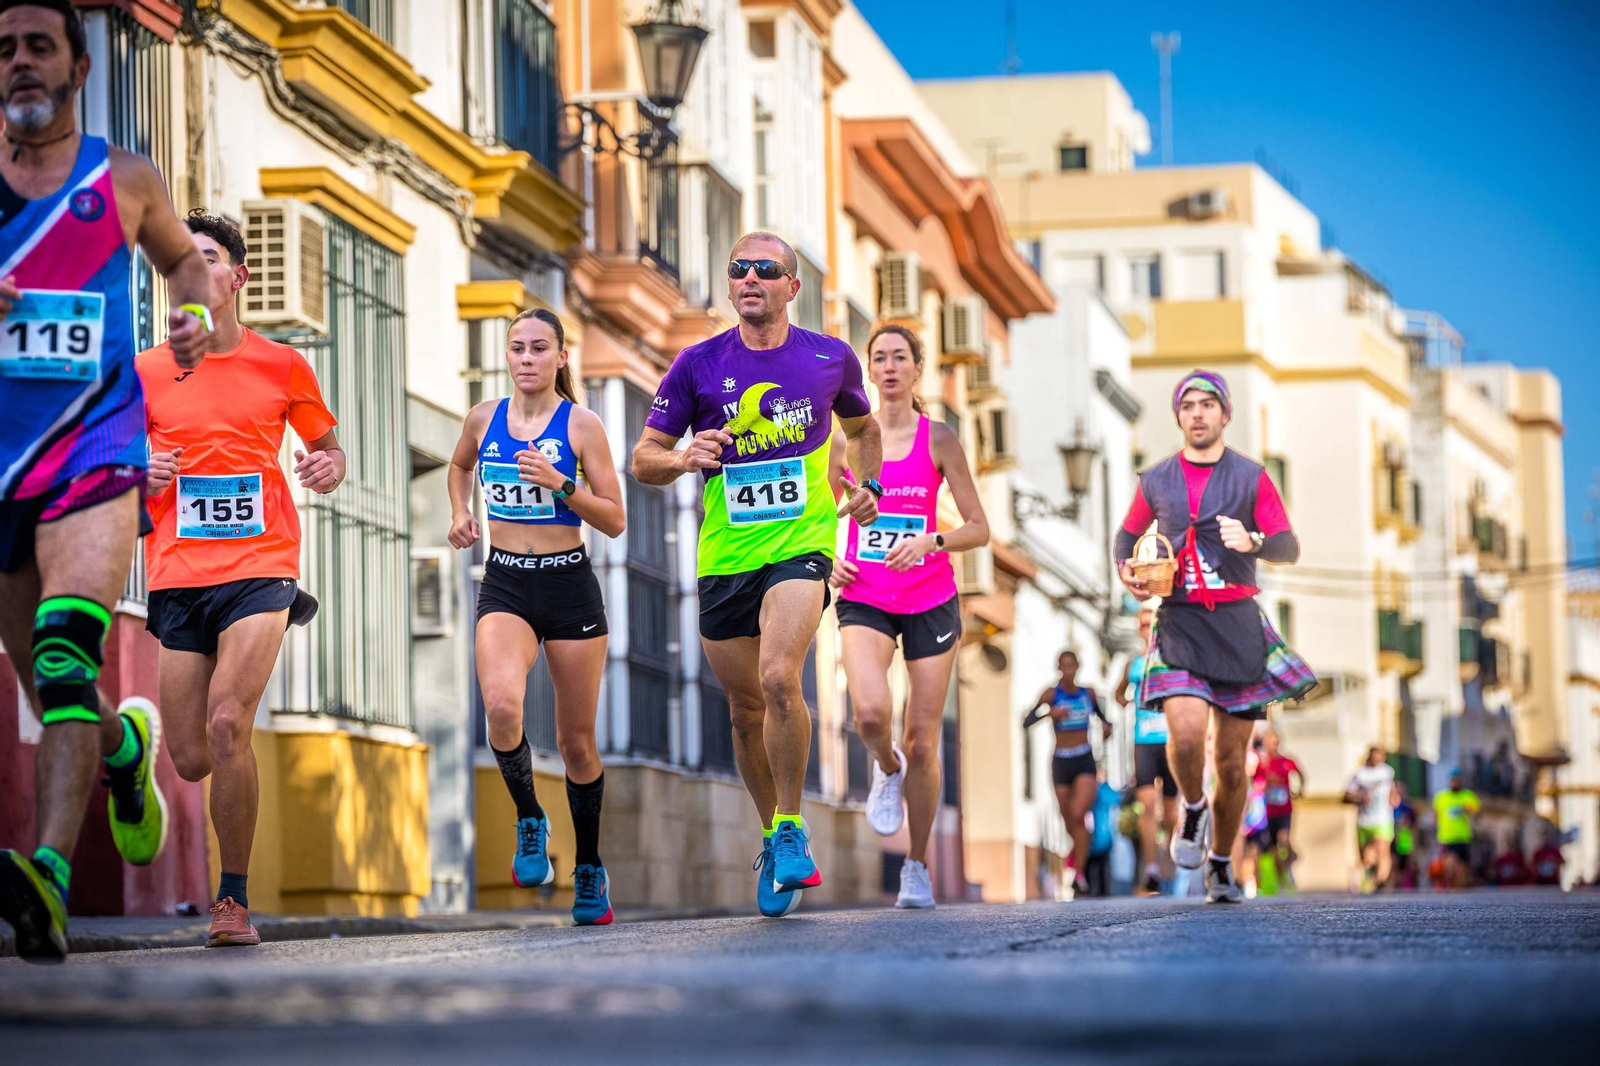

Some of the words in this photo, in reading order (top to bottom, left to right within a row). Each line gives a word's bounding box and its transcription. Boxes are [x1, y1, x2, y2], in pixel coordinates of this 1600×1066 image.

[7, 322, 90, 354] 119
[768, 397, 786, 407] LOS
[770, 397, 811, 414] TRUÑOS
[772, 405, 813, 428] NIGHT
[736, 423, 805, 457] RUNNING
[492, 484, 542, 504] 311
[737, 481, 798, 507] 418
[190, 497, 253, 522] 155
[753, 511, 780, 520] cajasur
[205, 528, 233, 537] cajasur
[868, 530, 916, 549] 27
[492, 551, 538, 568] NIKE
[540, 552, 582, 568] PRO
